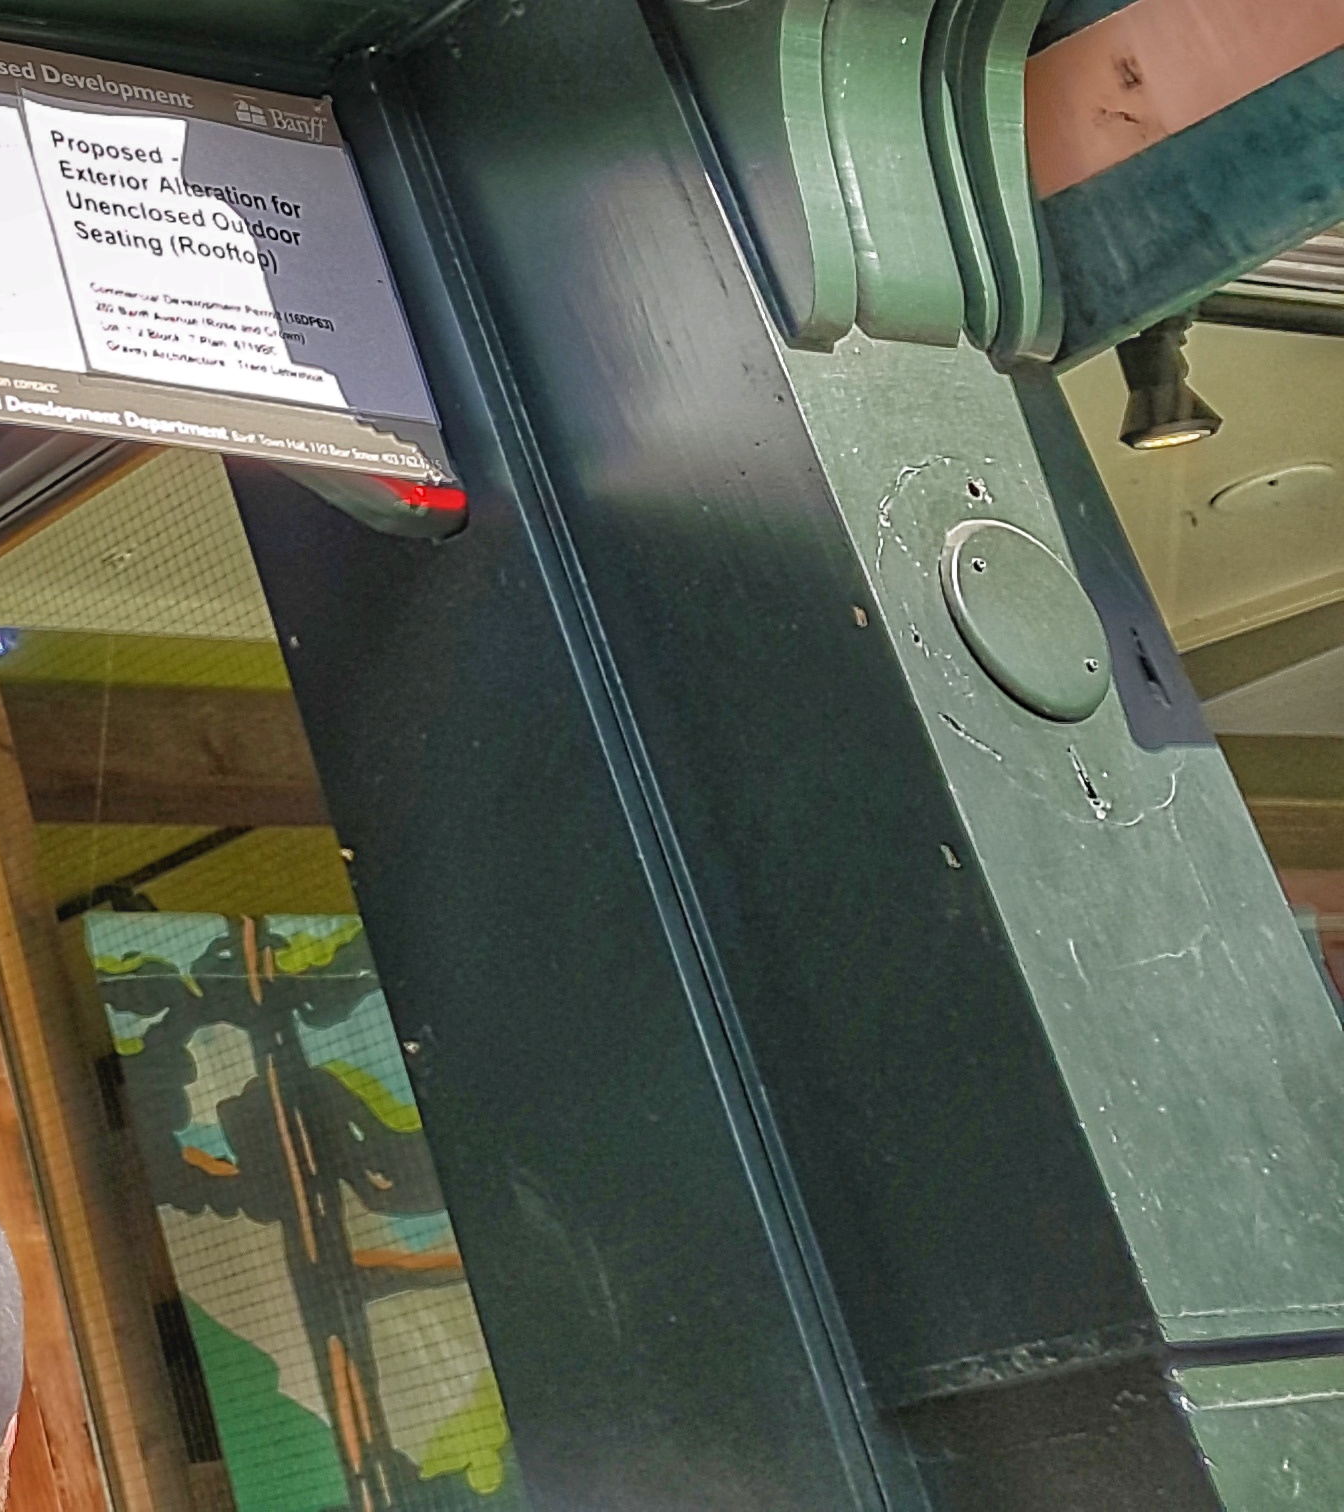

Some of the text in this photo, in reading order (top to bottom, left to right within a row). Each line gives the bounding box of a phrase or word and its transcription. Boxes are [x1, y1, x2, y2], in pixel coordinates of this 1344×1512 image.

[40, 63, 195, 110] Development
[50, 129, 164, 165] Proposed
[268, 107, 329, 142] Banff
[58, 159, 303, 220] Exterior Alteration for
[65, 189, 302, 247] Unenclosed Outdoor
[73, 220, 278, 275] Seating (Rooftop)
[4, 393, 123, 427] Development
